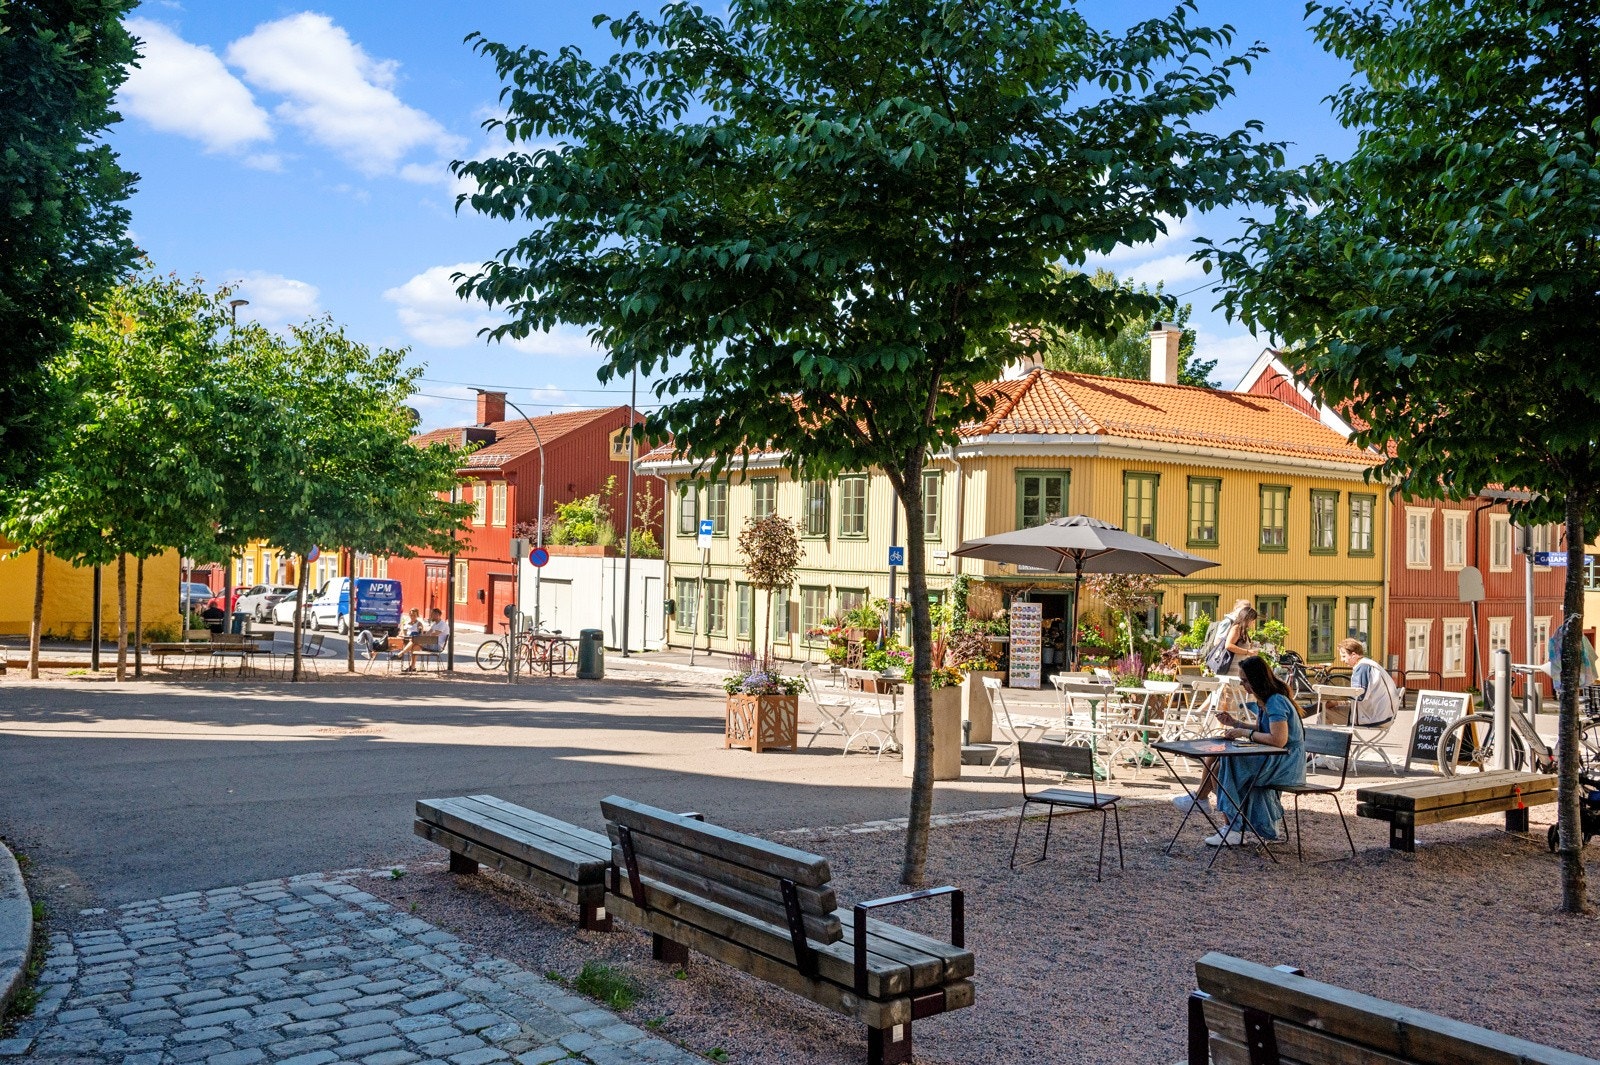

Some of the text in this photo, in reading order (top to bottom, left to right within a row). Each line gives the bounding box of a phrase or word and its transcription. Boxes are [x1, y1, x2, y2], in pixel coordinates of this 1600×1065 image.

[370, 583, 392, 592] NPM
[1422, 697, 1459, 707] VENNLIGST
[1437, 708, 1456, 716] FLYTT
[1418, 724, 1438, 733] PLEASE
